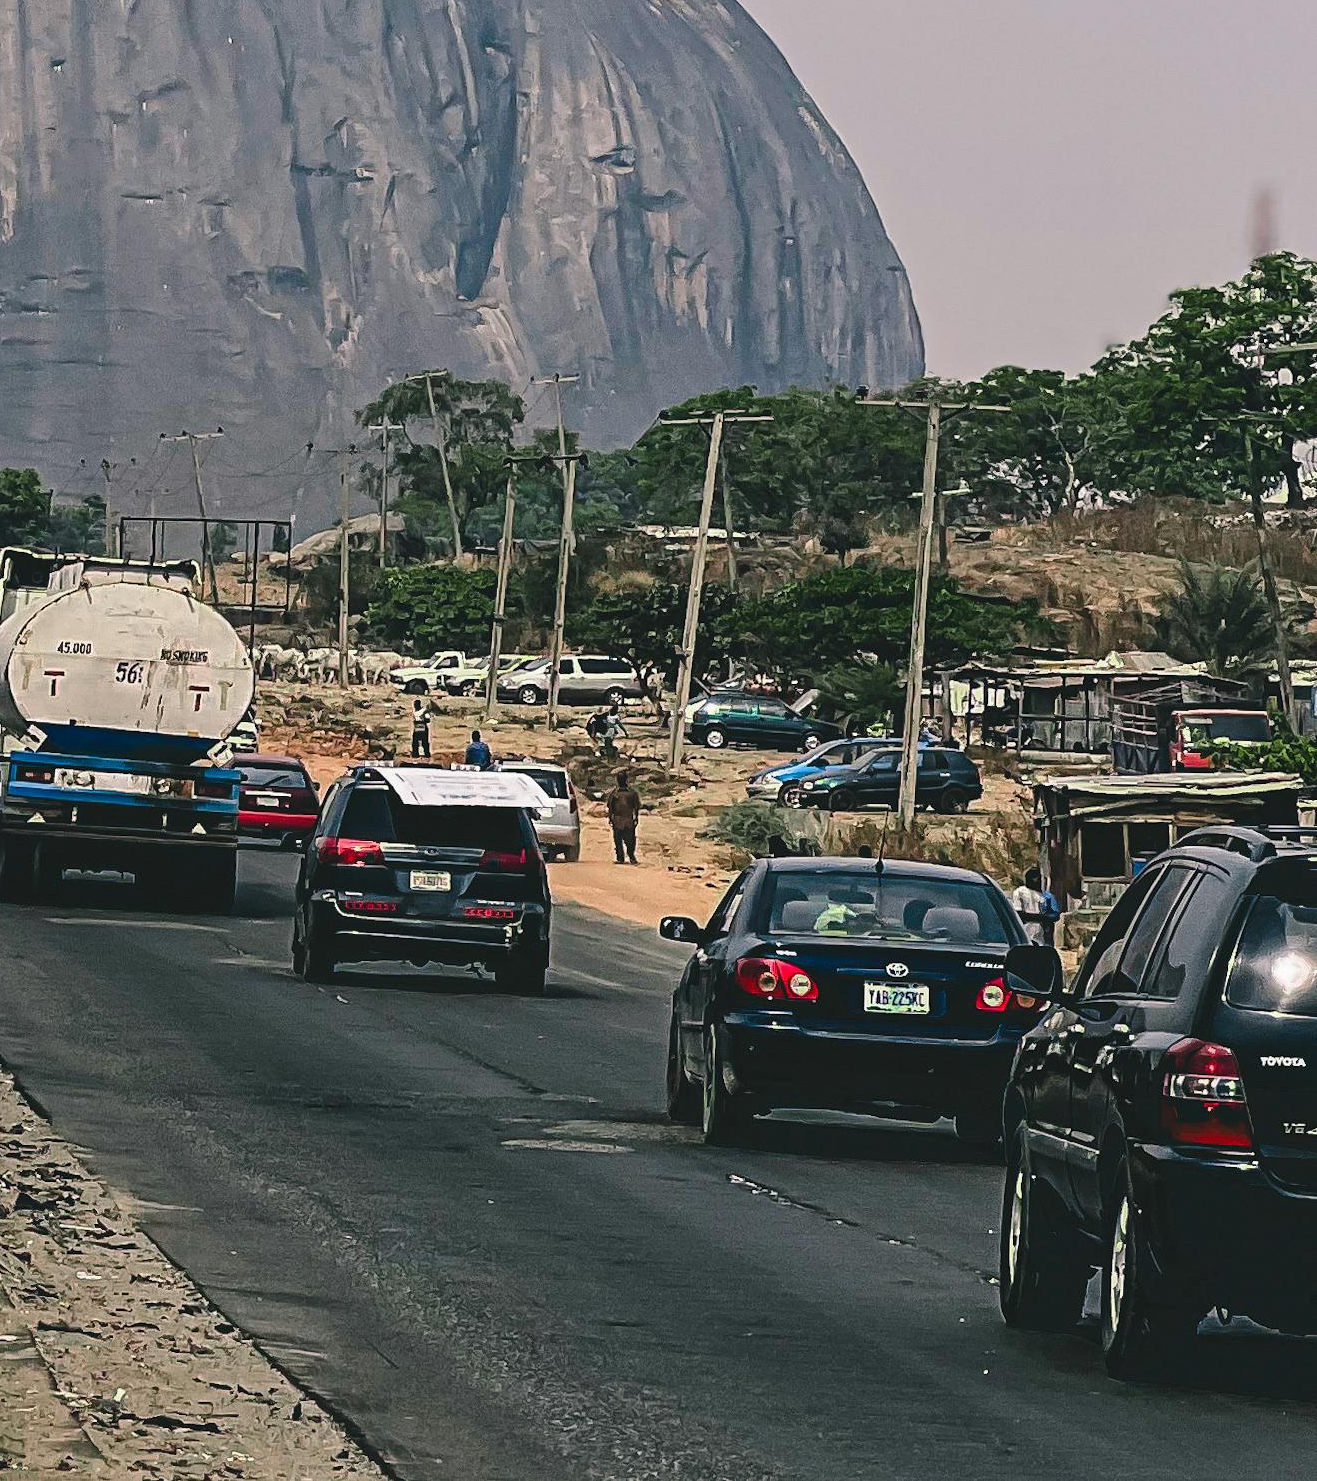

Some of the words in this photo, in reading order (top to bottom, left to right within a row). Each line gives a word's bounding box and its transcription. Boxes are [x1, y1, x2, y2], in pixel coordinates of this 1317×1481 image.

[44, 670, 65, 696] T
[189, 685, 210, 712] T
[1260, 1056, 1307, 1067] TOYOTA
